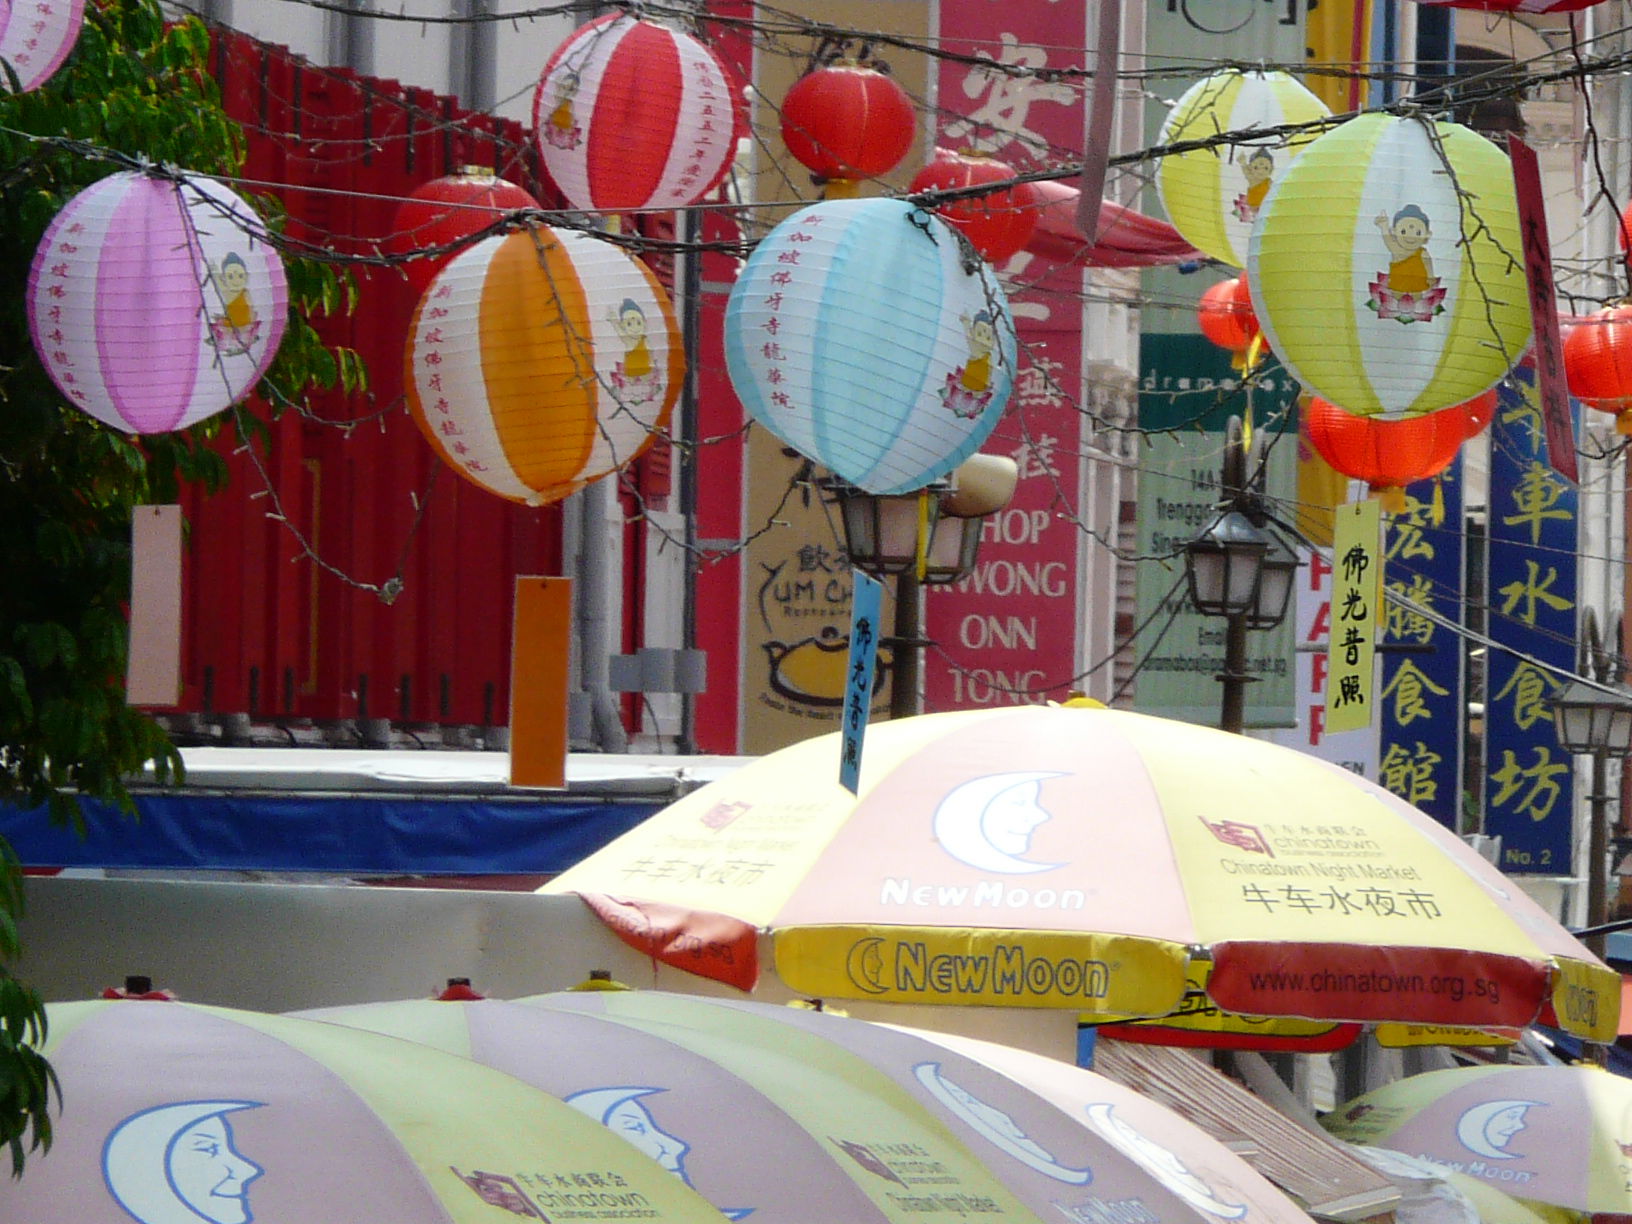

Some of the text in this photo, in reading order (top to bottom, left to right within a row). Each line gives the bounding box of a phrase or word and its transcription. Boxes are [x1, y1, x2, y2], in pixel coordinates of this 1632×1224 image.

[979, 509, 1051, 544] HOP
[932, 560, 1067, 597] WONG
[960, 614, 1037, 650] ONN
[948, 669, 1047, 705] TONG
[1273, 835, 1380, 850] chinatown
[1506, 849, 1551, 866] No. 2
[1220, 858, 1422, 882] Chinatown Night Market
[1241, 882, 1442, 920] 牛车水夜市
[1248, 971, 1500, 1005] www.chinatown.org.sg
[536, 1189, 650, 1208] chinatown
